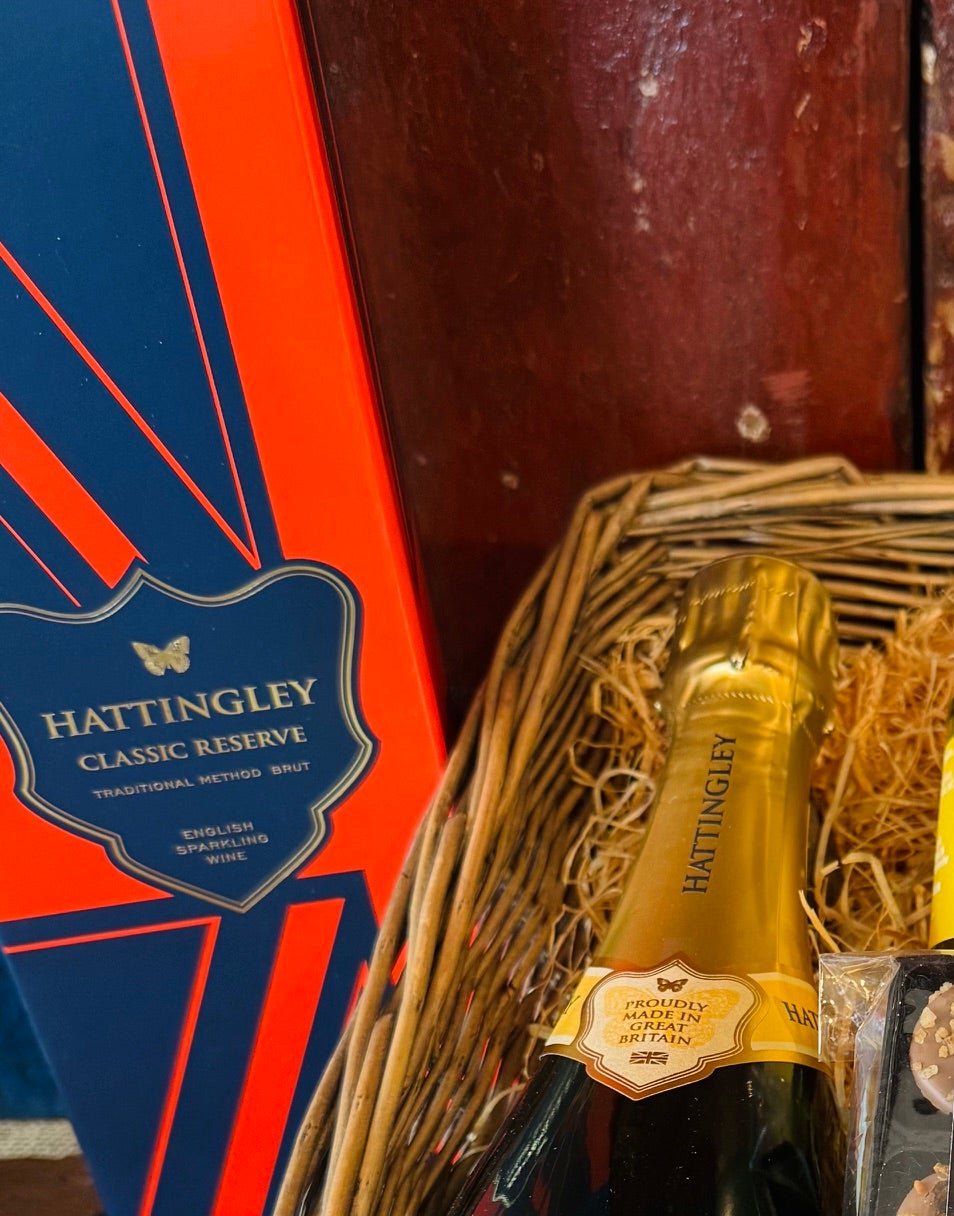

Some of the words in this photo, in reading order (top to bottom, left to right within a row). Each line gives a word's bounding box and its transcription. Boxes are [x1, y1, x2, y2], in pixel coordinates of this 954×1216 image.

[41, 678, 317, 739] HATTINGLEY
[78, 743, 188, 772] CLASSIC
[197, 726, 307, 757] RESERVE
[93, 778, 194, 799] TRADITIONAL
[199, 768, 261, 785] METHOD
[271, 762, 311, 776] BRUT
[682, 733, 737, 895] HATTINGLEY
[183, 821, 254, 840] ENGLISH
[176, 833, 268, 856] SPARKLING
[206, 851, 247, 865] WINE
[625, 998, 709, 1012] PROUDLY
[623, 1009, 674, 1022] MADE
[680, 1011, 702, 1024] IN
[629, 1021, 688, 1033] GREAT
[619, 1032, 692, 1046] BRITAIN
